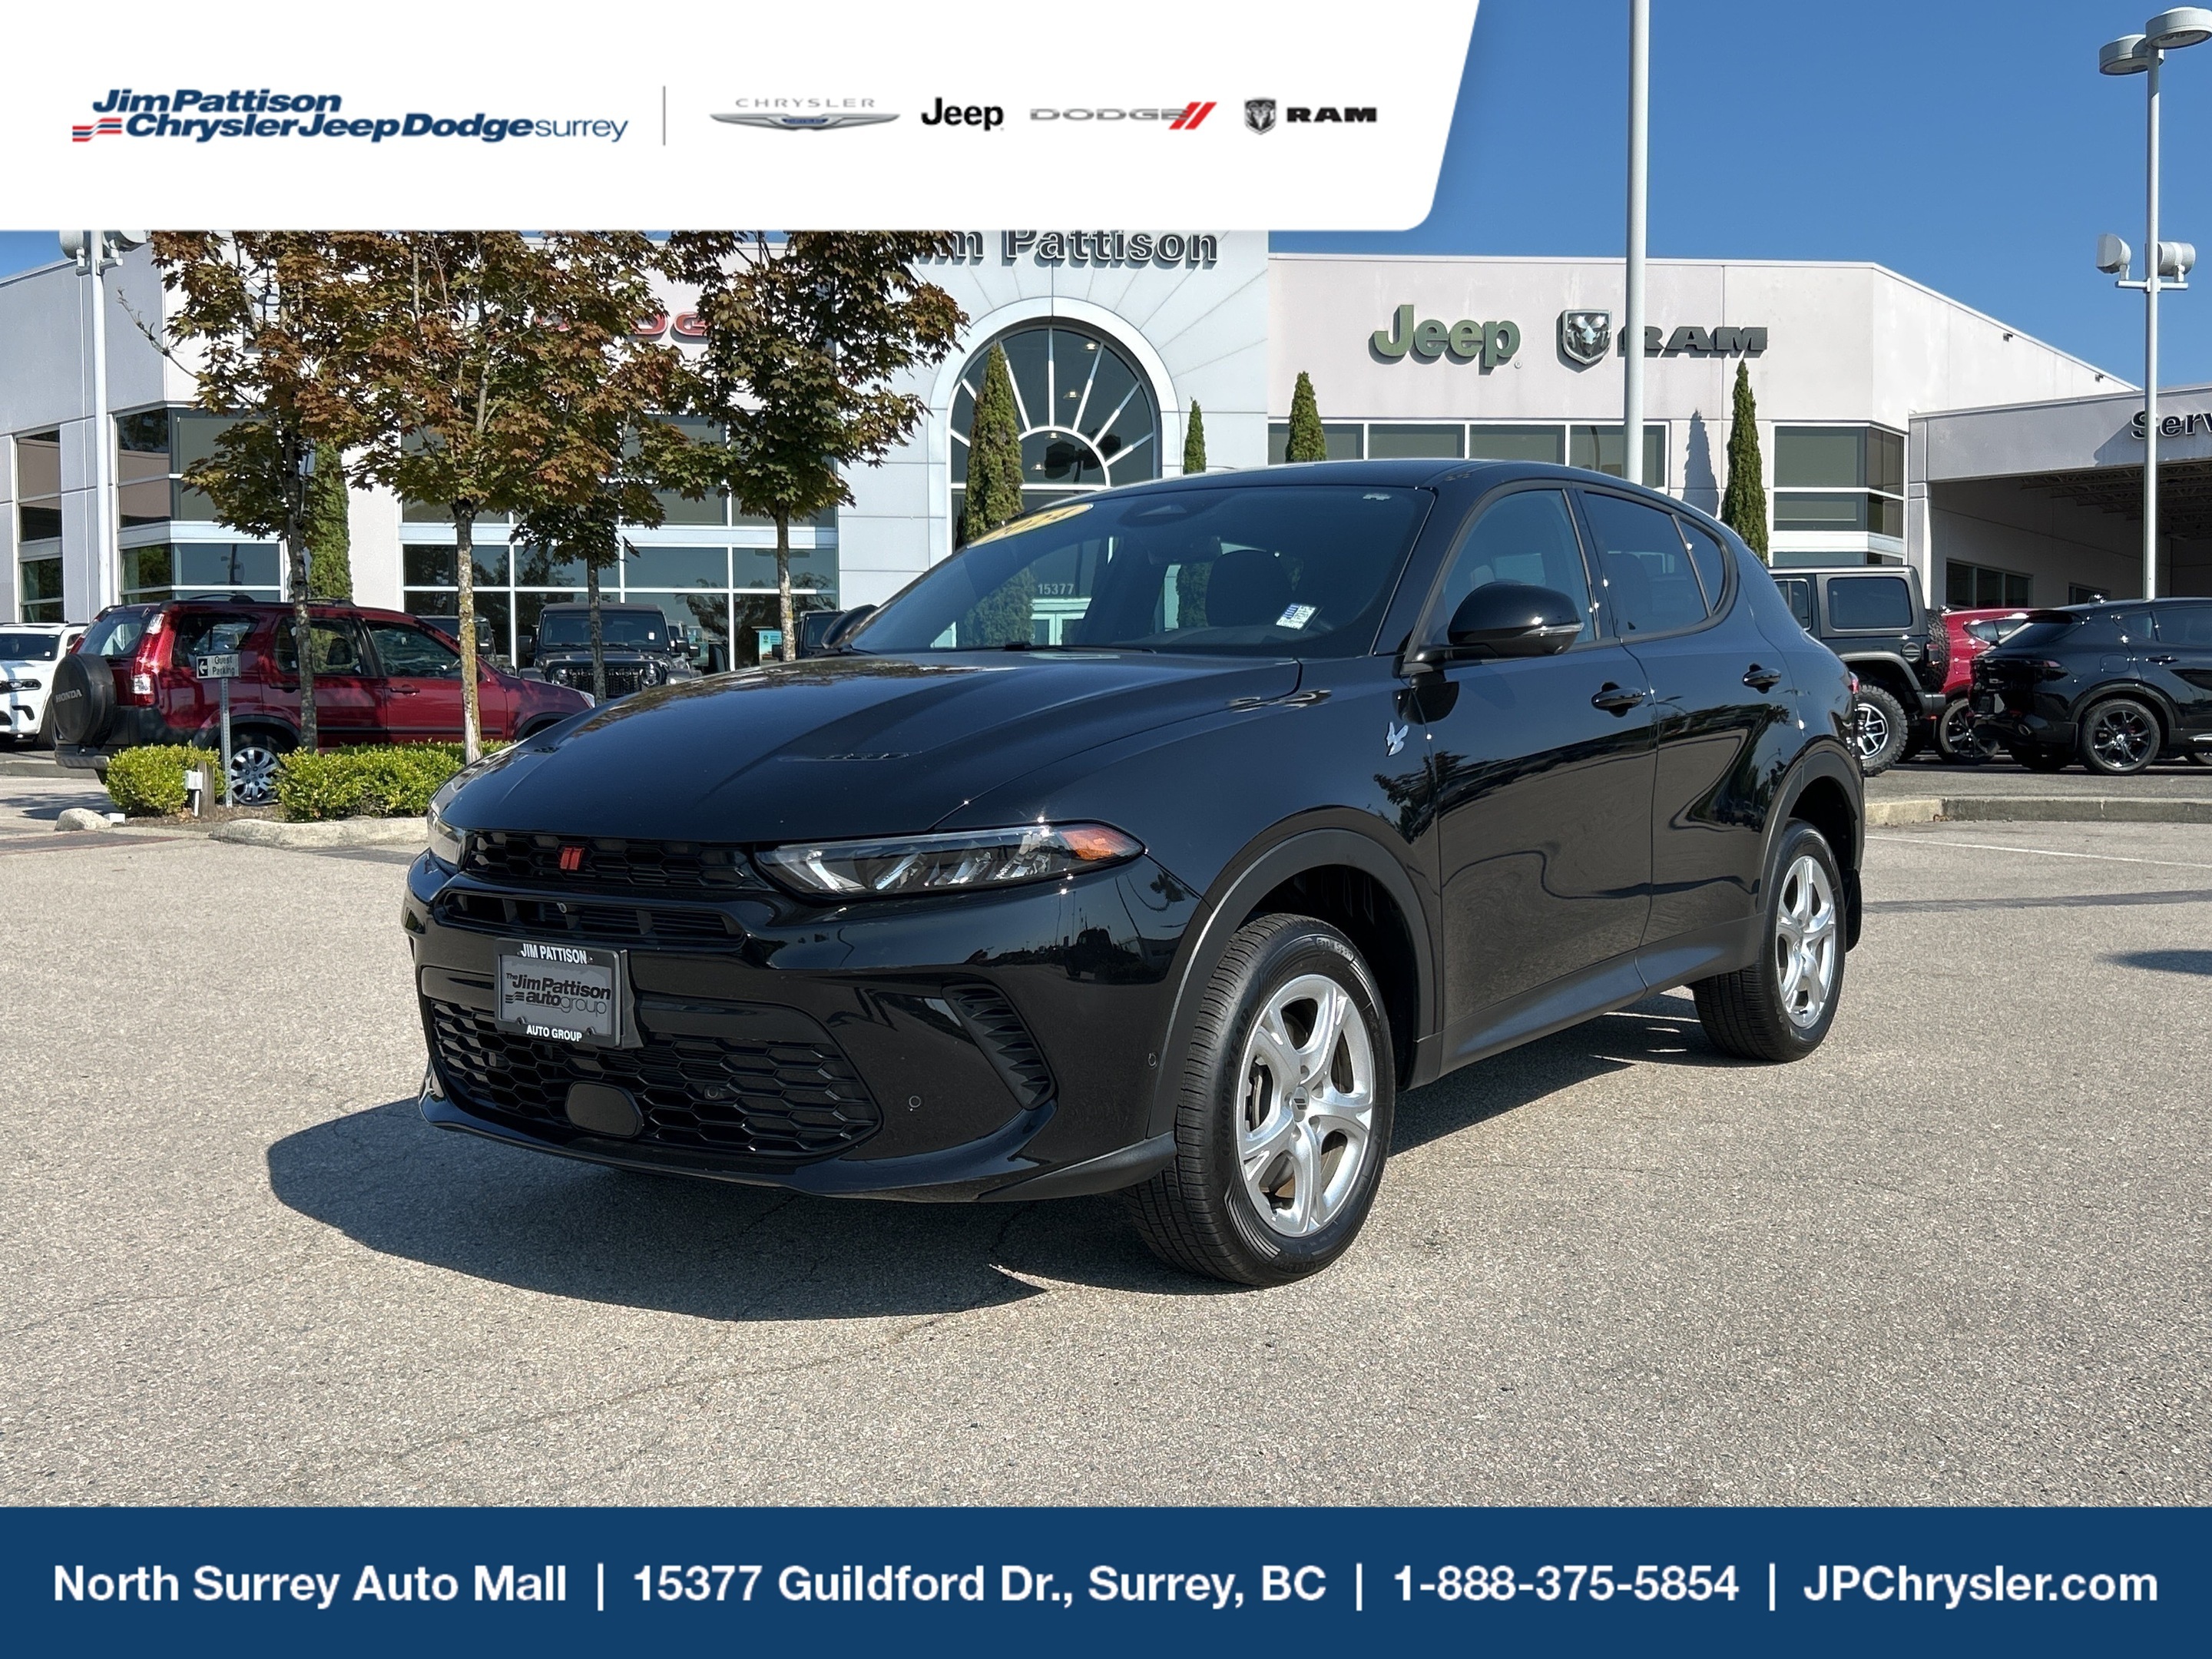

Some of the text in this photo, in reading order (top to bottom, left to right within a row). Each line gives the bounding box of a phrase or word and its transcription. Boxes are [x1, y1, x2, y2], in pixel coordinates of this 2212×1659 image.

[1006, 230, 1218, 261] Pattison
[1373, 305, 1521, 368] Jeep
[1038, 583, 1075, 595] 15377
[214, 655, 233, 665] Guest
[212, 666, 236, 677] Parking
[55, 688, 83, 704] HONDA
[520, 943, 588, 965] JIM PATTISON
[505, 972, 518, 981] The
[526, 1024, 583, 1042] AUTO GROUP
